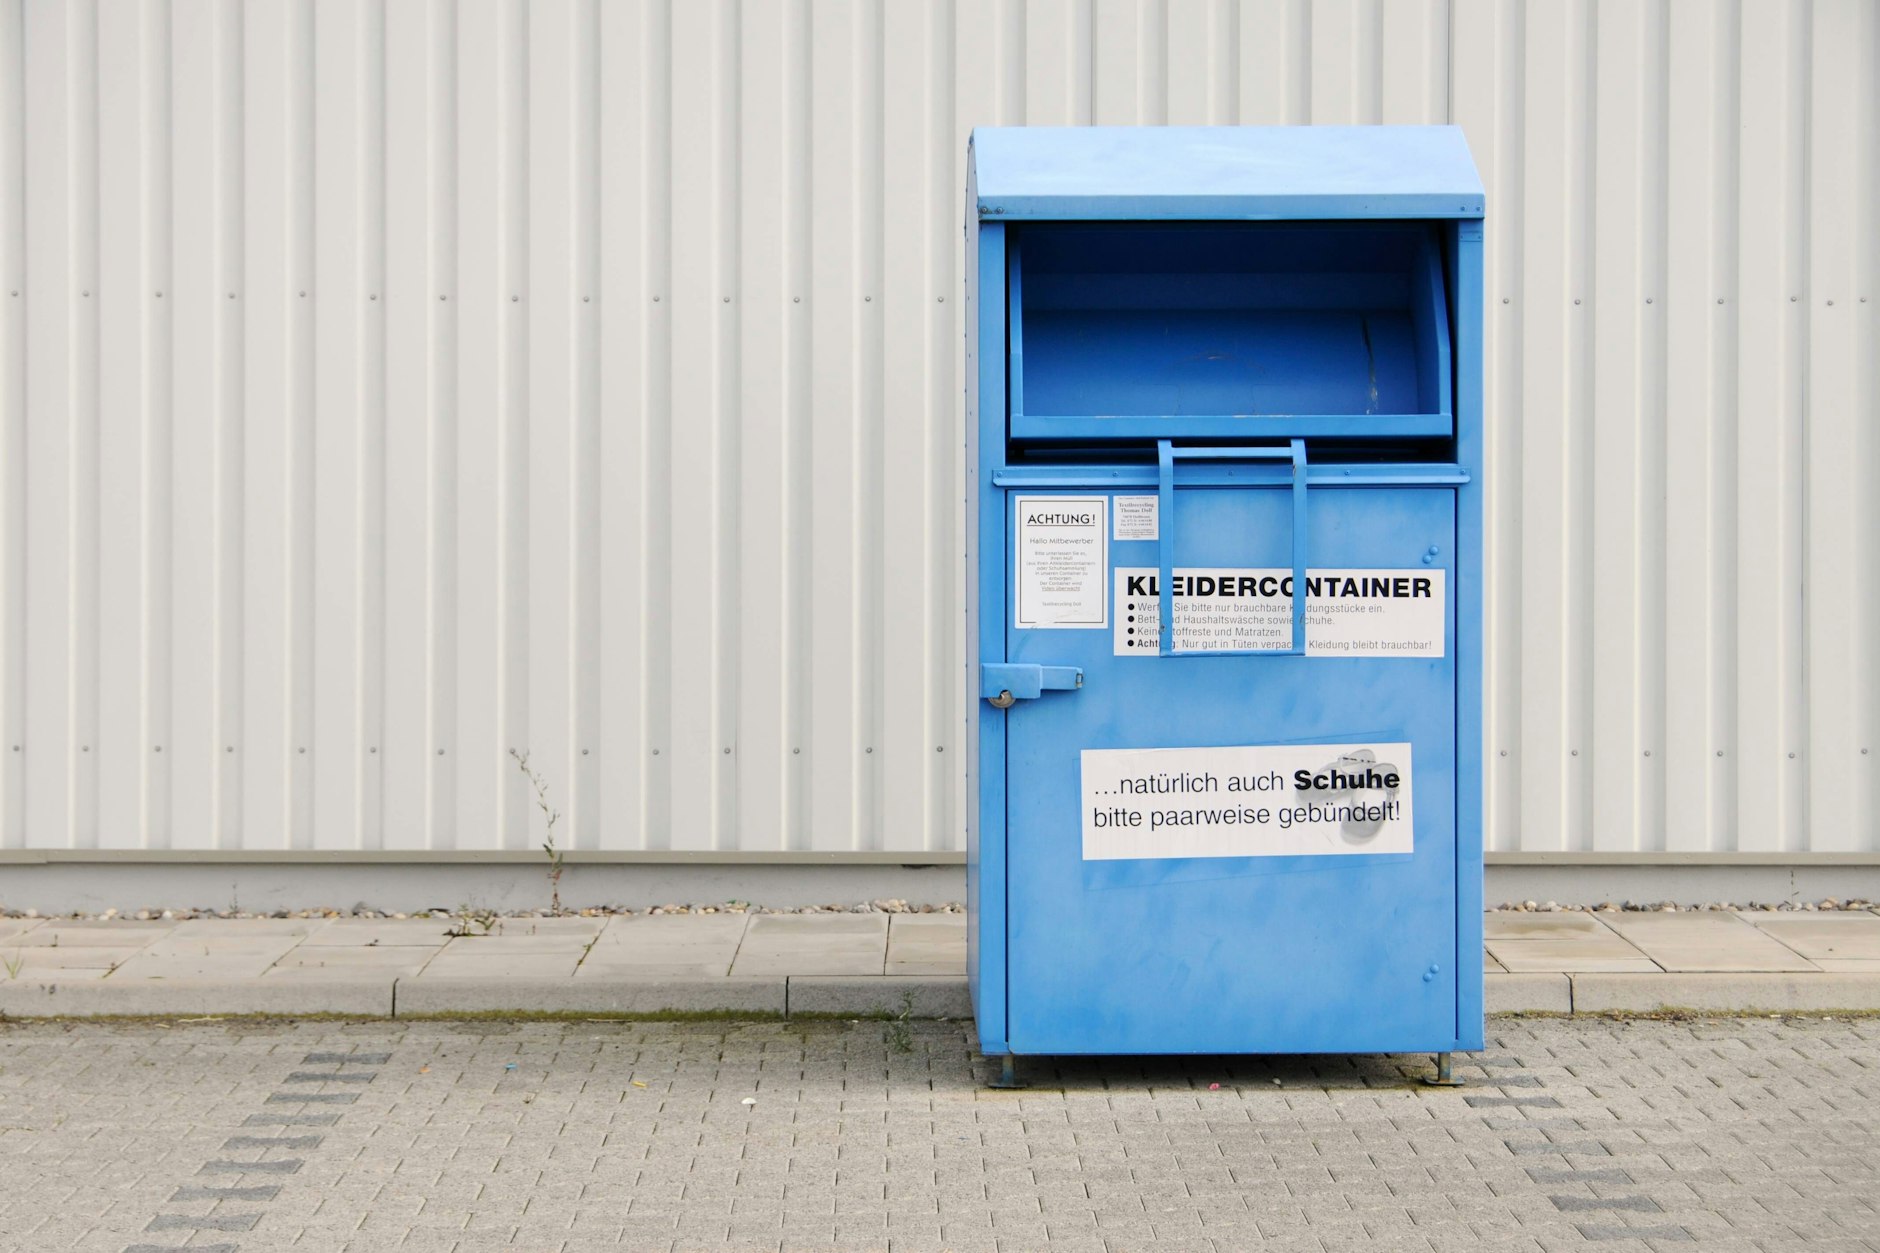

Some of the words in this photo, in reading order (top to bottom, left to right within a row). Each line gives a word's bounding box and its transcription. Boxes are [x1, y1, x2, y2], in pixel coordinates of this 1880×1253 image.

[1027, 514, 1096, 525] ACHTUNG!
[1029, 537, 1048, 545] Hallo
[1049, 537, 1094, 545] Mitbewerber
[1127, 576, 1432, 598] KLEIDERCONTAINER
[1174, 603, 1189, 612] Sie
[1191, 603, 1212, 612] bitte
[1233, 603, 1287, 613] brauchbare
[1368, 604, 1386, 613] ein.
[1183, 615, 1266, 624] Haushaltswäsche
[1267, 616, 1293, 625] sowie
[1305, 616, 1335, 625] chuhe.
[1172, 627, 1212, 636] toffreste
[1214, 627, 1232, 636] und
[1235, 627, 1284, 637] Matratzen.
[1182, 640, 1200, 648] Nur
[1202, 640, 1217, 650] gut
[1220, 639, 1229, 648] in
[1231, 639, 1258, 649] Tüten
[1308, 640, 1350, 651] Kleidung
[1352, 641, 1379, 649] bleibt
[1381, 641, 1433, 650] brauchbar!
[1228, 771, 1285, 793] auch
[1294, 769, 1401, 791] Schuhe
[1094, 807, 1142, 828] bitte
[1151, 804, 1271, 831] paarweise
[1279, 801, 1401, 829] gebündelt!
